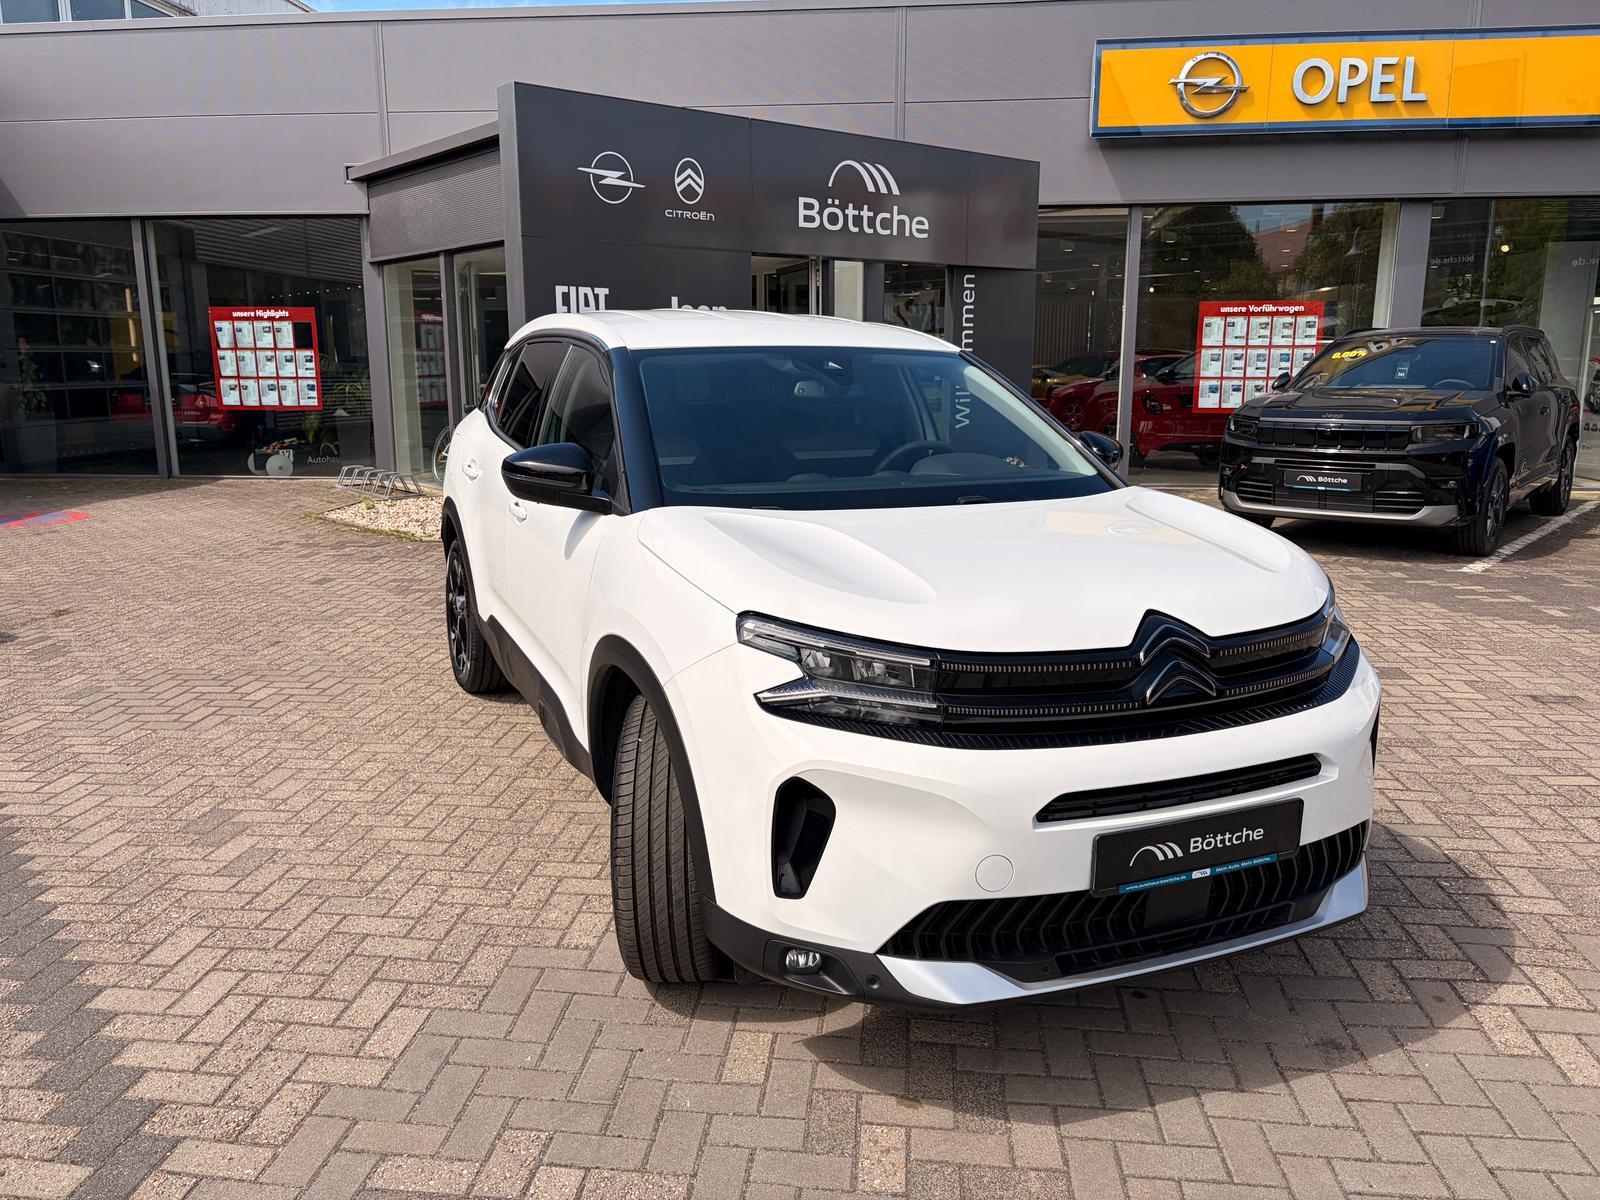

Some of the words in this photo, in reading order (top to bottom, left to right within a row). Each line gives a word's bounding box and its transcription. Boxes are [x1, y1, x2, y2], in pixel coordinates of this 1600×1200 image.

[1293, 56, 1427, 105] OPEL
[798, 196, 930, 239] Böttche
[555, 285, 609, 313] FIAT
[256, 310, 289, 319] Highlights
[1248, 304, 1305, 314] Vorführwagen
[307, 456, 341, 464] Autohau
[1317, 476, 1348, 484] Böttche
[1189, 827, 1264, 854] Böttche
